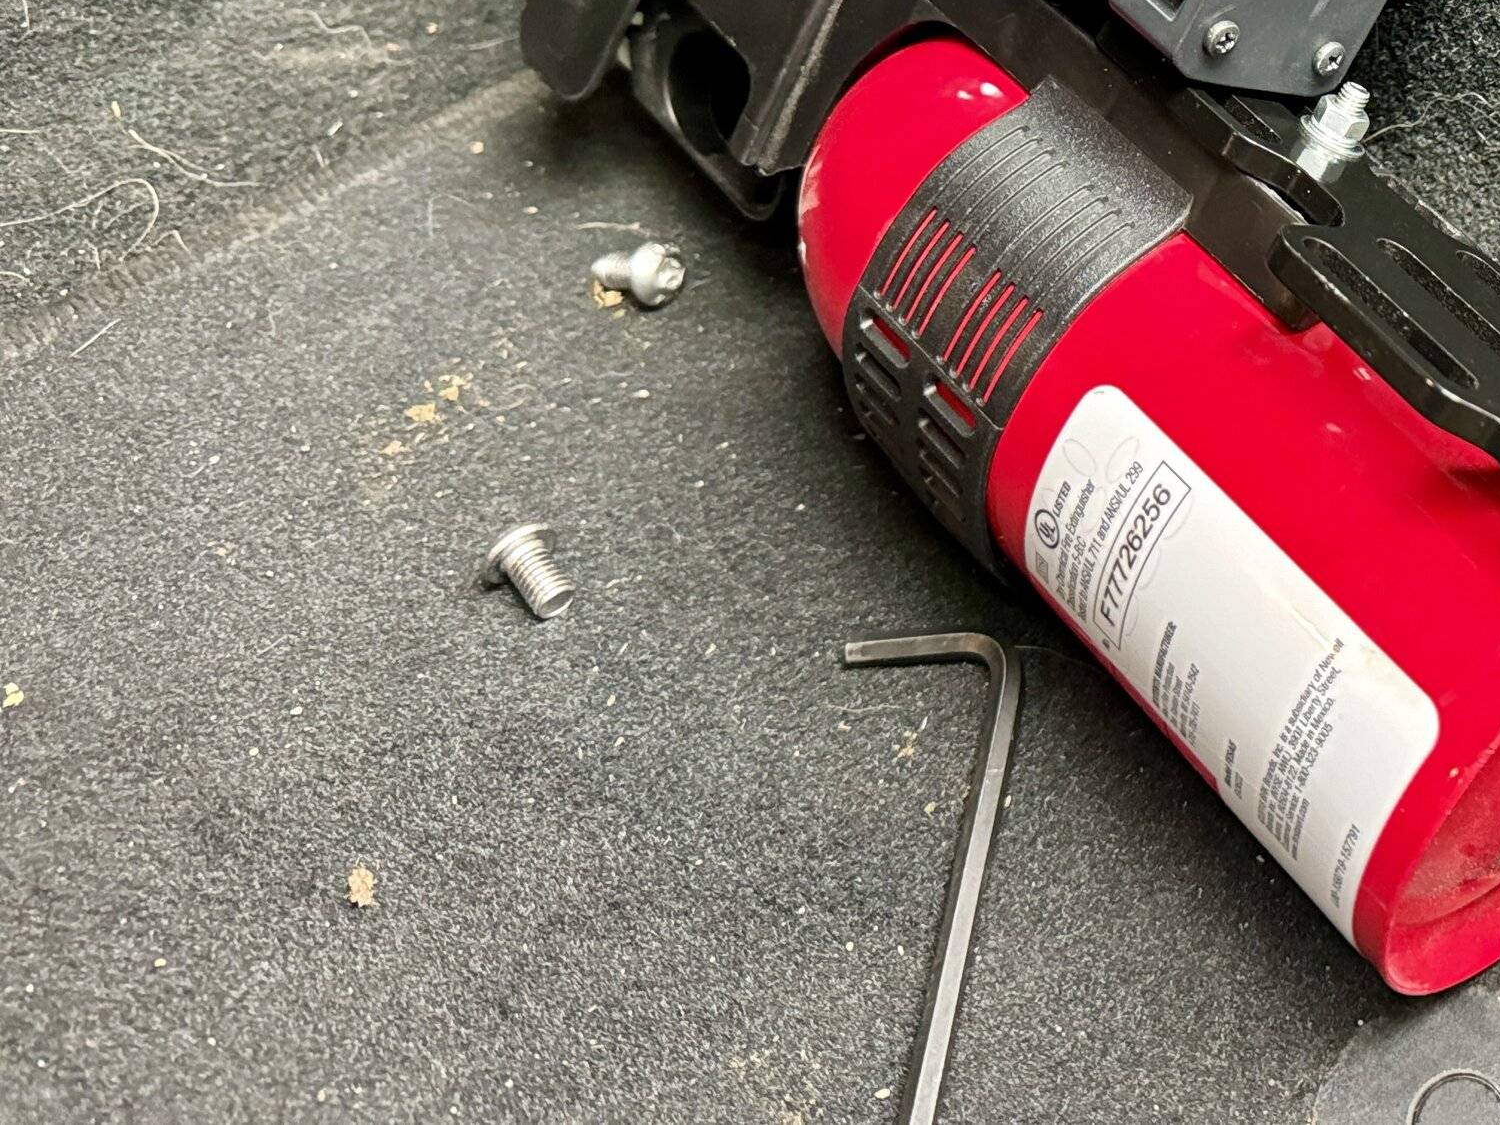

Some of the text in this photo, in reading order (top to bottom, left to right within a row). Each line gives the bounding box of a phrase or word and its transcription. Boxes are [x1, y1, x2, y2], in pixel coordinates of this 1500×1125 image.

[1052, 480, 1072, 518] LISTED
[1065, 479, 1096, 535] Extinguisher
[1087, 540, 1102, 561] 711
[1096, 517, 1110, 541] and
[1103, 483, 1132, 523] ANSI/UL
[1125, 460, 1144, 485] 299
[1060, 532, 1073, 553] Fire
[1100, 483, 1172, 626] F77726256
[1279, 732, 1288, 742] is
[1288, 681, 1316, 726] subsidiary
[1313, 669, 1322, 682] of
[1293, 739, 1310, 764] Made
[1311, 697, 1335, 729] Mexico.
[1299, 696, 1323, 725] Liberty
